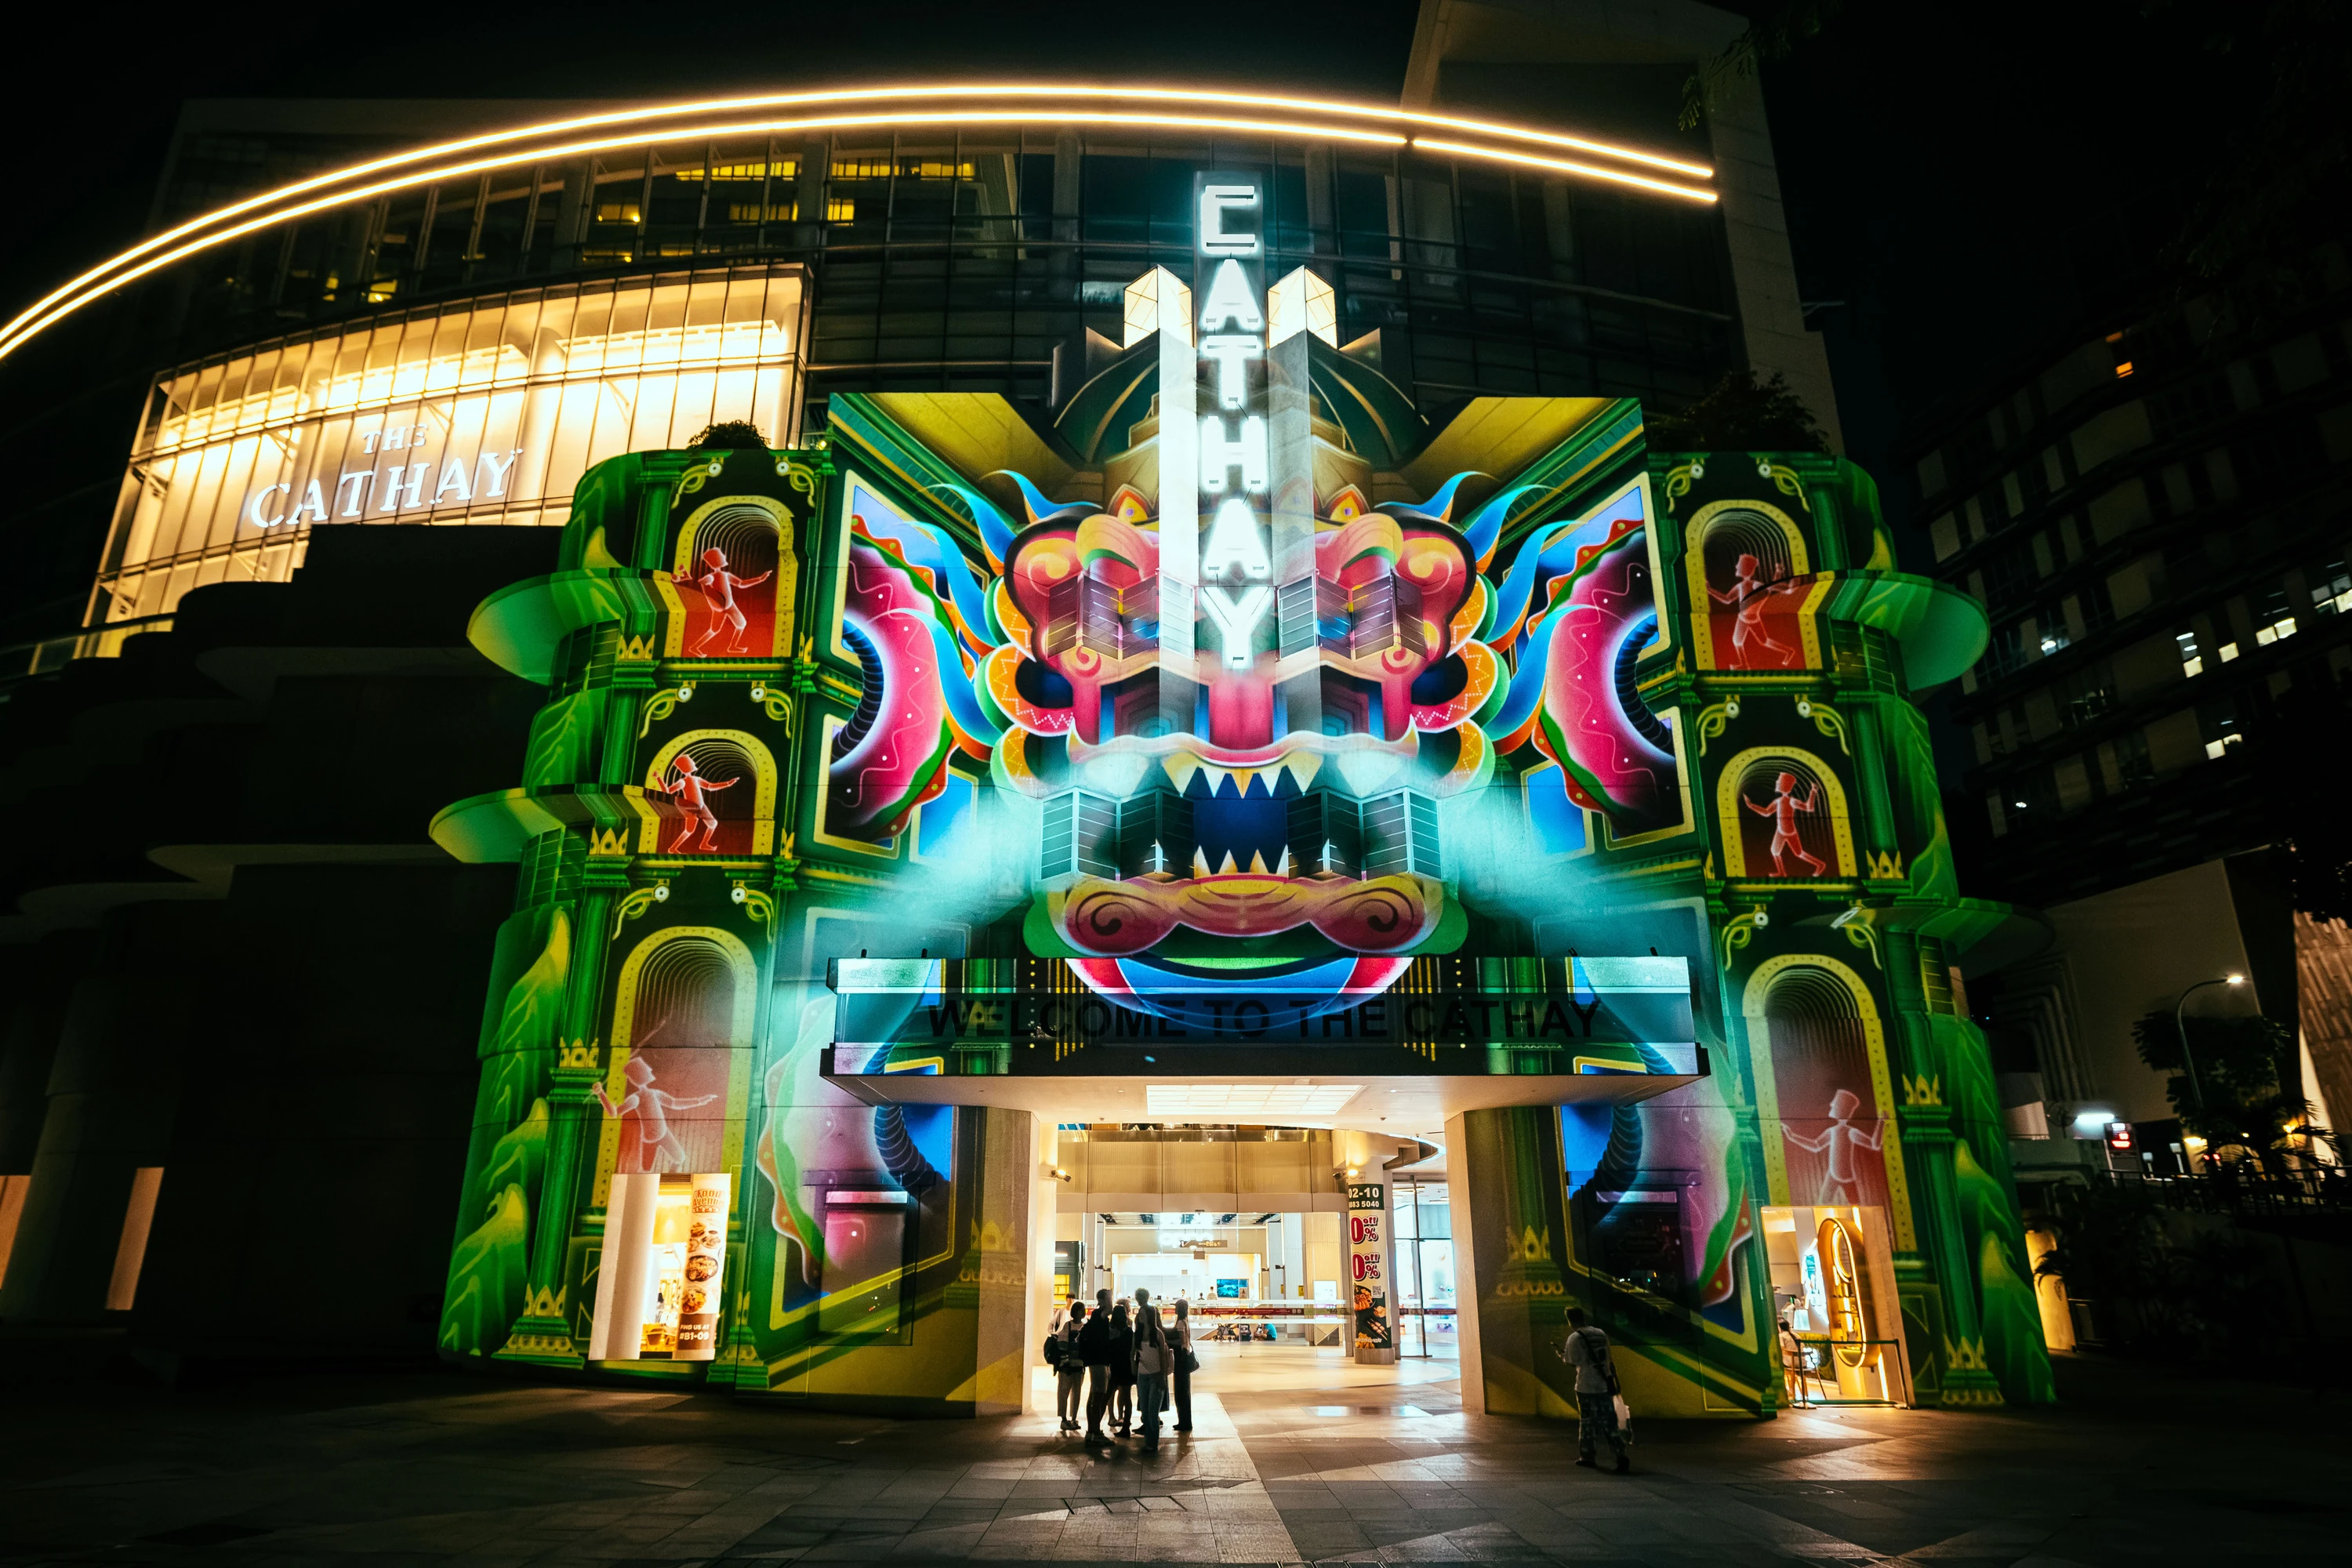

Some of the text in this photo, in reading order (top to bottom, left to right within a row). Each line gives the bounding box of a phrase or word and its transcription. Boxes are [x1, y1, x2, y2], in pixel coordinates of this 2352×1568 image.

[363, 423, 429, 455] THE
[1200, 184, 1272, 668] CATHAY
[250, 448, 524, 528] CATHAY
[928, 999, 1601, 1038] WELCOME TO THE CATHAY
